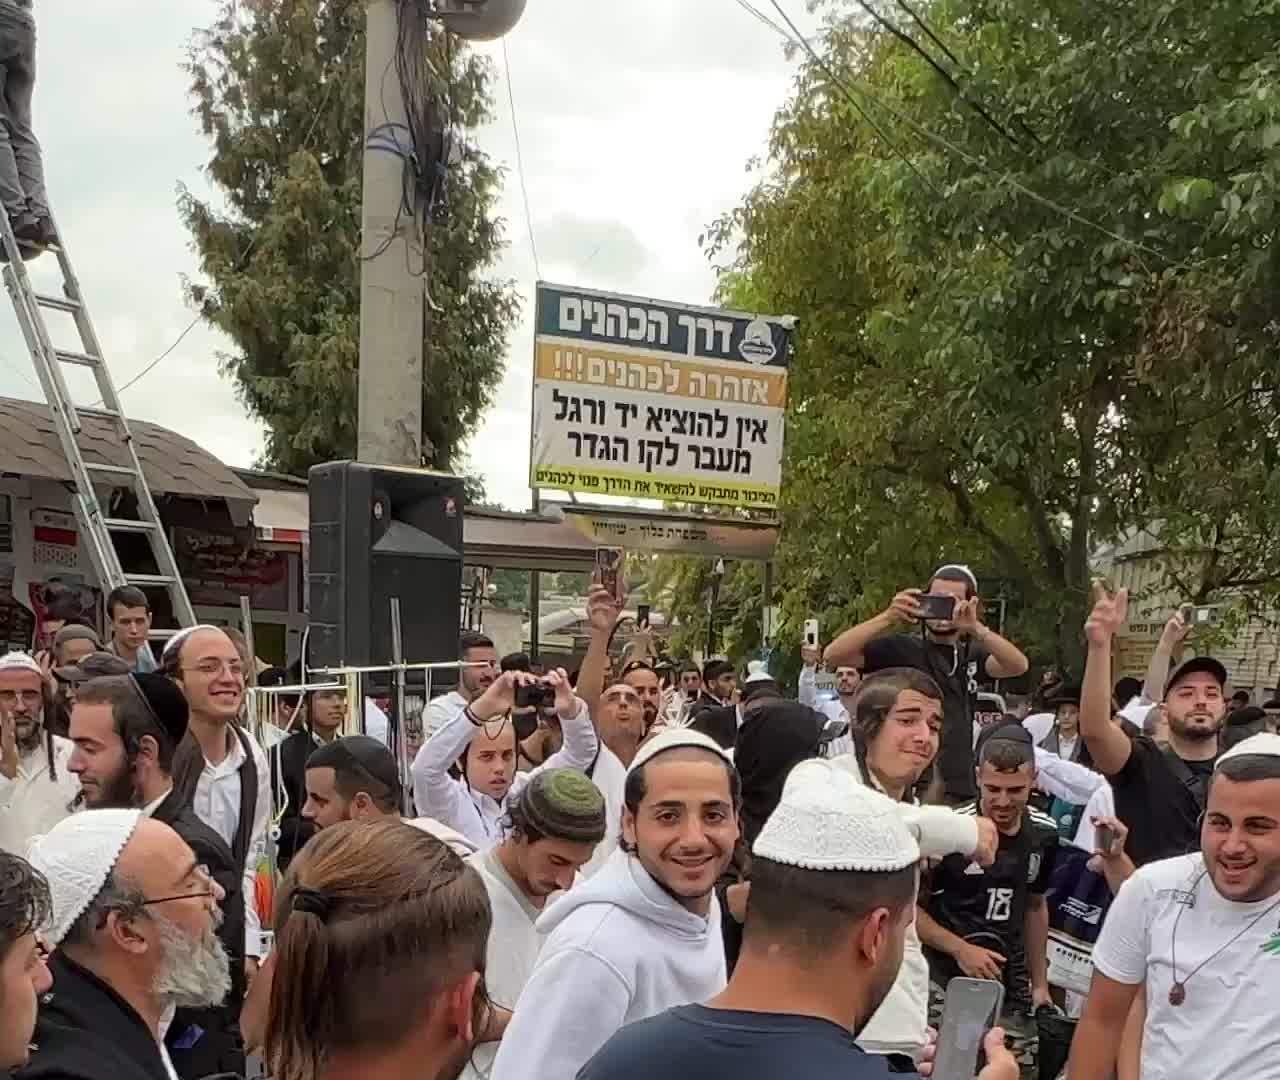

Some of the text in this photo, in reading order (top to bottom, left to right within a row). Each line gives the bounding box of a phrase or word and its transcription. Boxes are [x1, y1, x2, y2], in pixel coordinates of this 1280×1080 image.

[559, 296, 734, 357] דרך הכהנים
[688, 371, 769, 404] אזהרה
[552, 388, 769, 448] אין להוציא יד ורגל
[567, 431, 752, 474] מעבר לקו הגדר
[535, 469, 575, 485] לכהנים
[578, 474, 600, 487] פנוי
[602, 476, 632, 492] הדרך
[634, 480, 651, 494] את
[699, 486, 740, 501] מתבקש
[741, 490, 776, 503] הציבור
